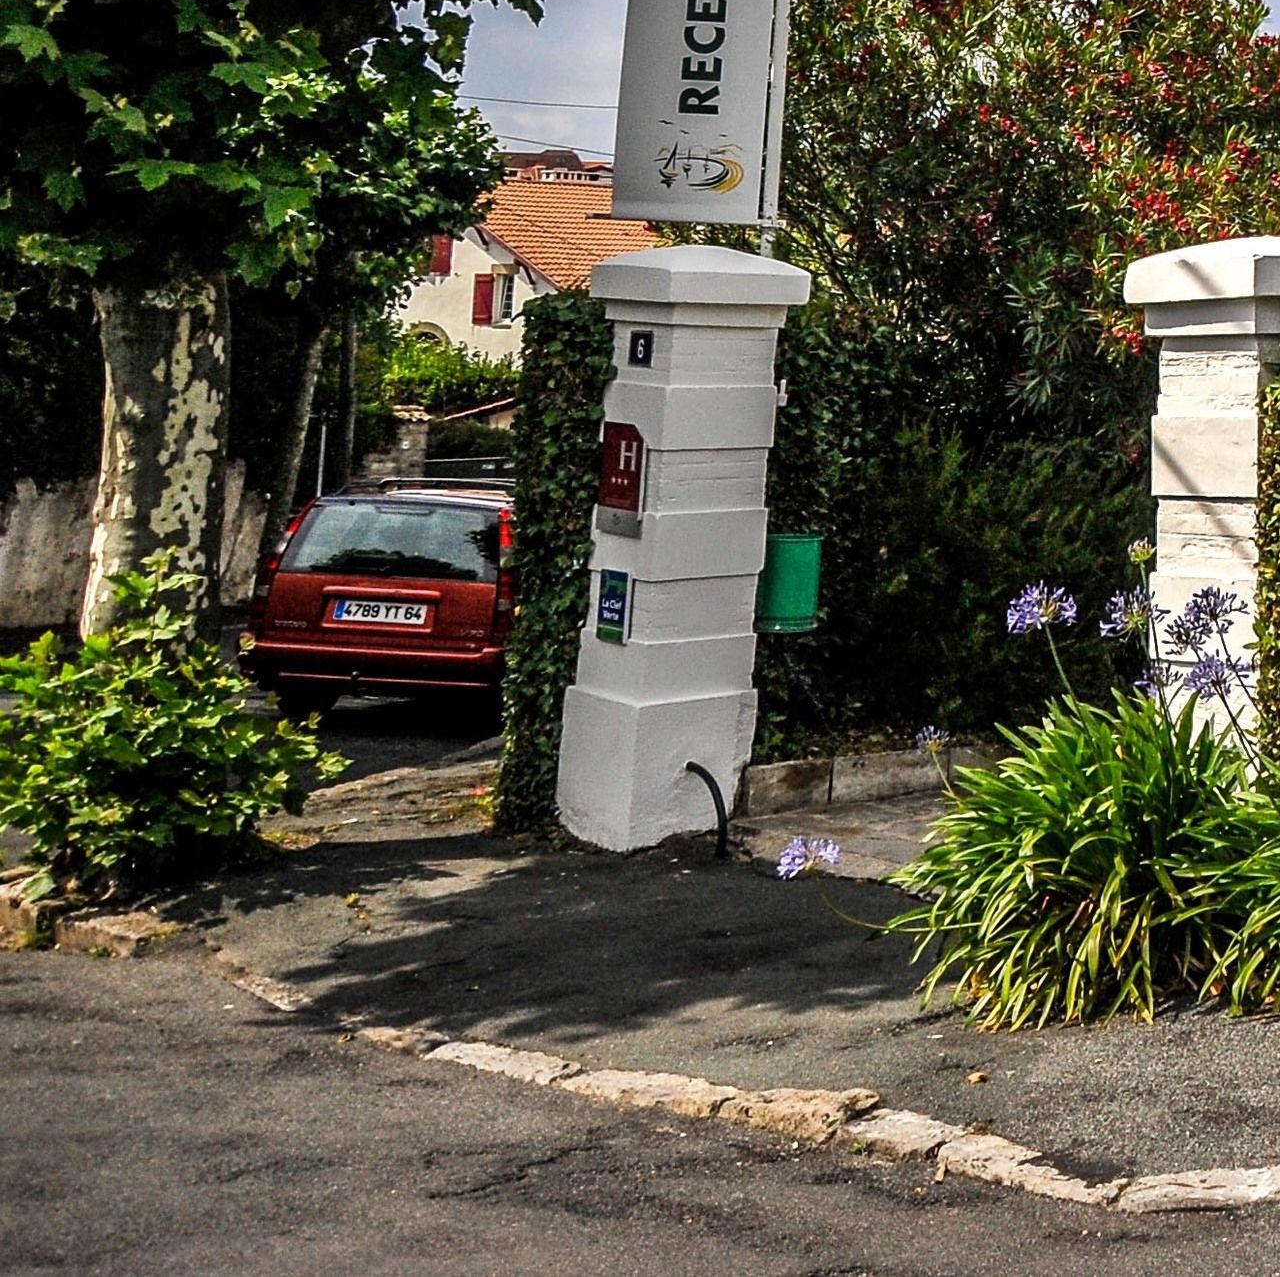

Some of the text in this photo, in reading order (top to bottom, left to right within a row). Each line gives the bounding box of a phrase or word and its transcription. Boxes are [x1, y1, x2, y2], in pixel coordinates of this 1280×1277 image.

[637, 338, 645, 359] 6
[619, 441, 638, 472] H
[343, 603, 423, 621] 4789 YT 64
